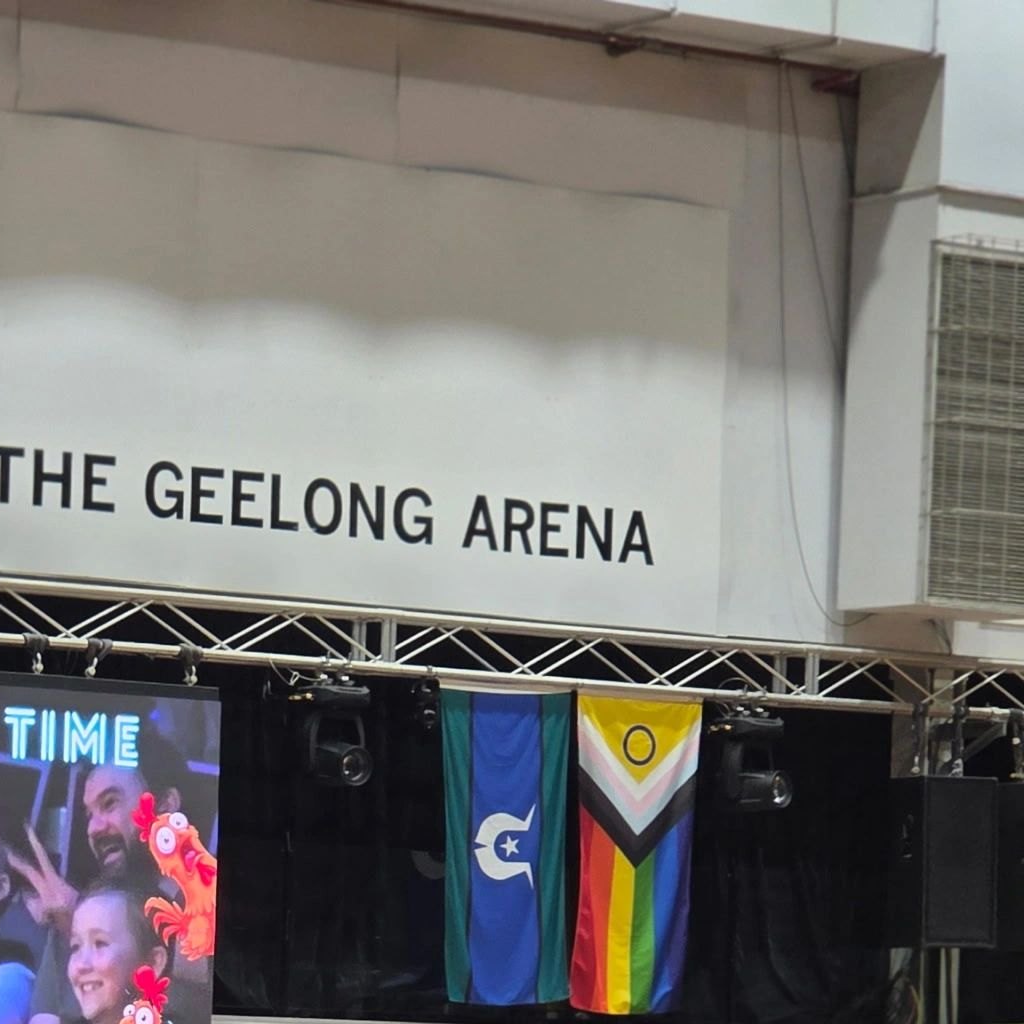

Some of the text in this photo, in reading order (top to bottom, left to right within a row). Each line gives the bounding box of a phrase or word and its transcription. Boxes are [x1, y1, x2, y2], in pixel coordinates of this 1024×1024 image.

[144, 460, 433, 545] GEELONG
[462, 494, 654, 566] ARENA
[4, 706, 141, 768] TIME
